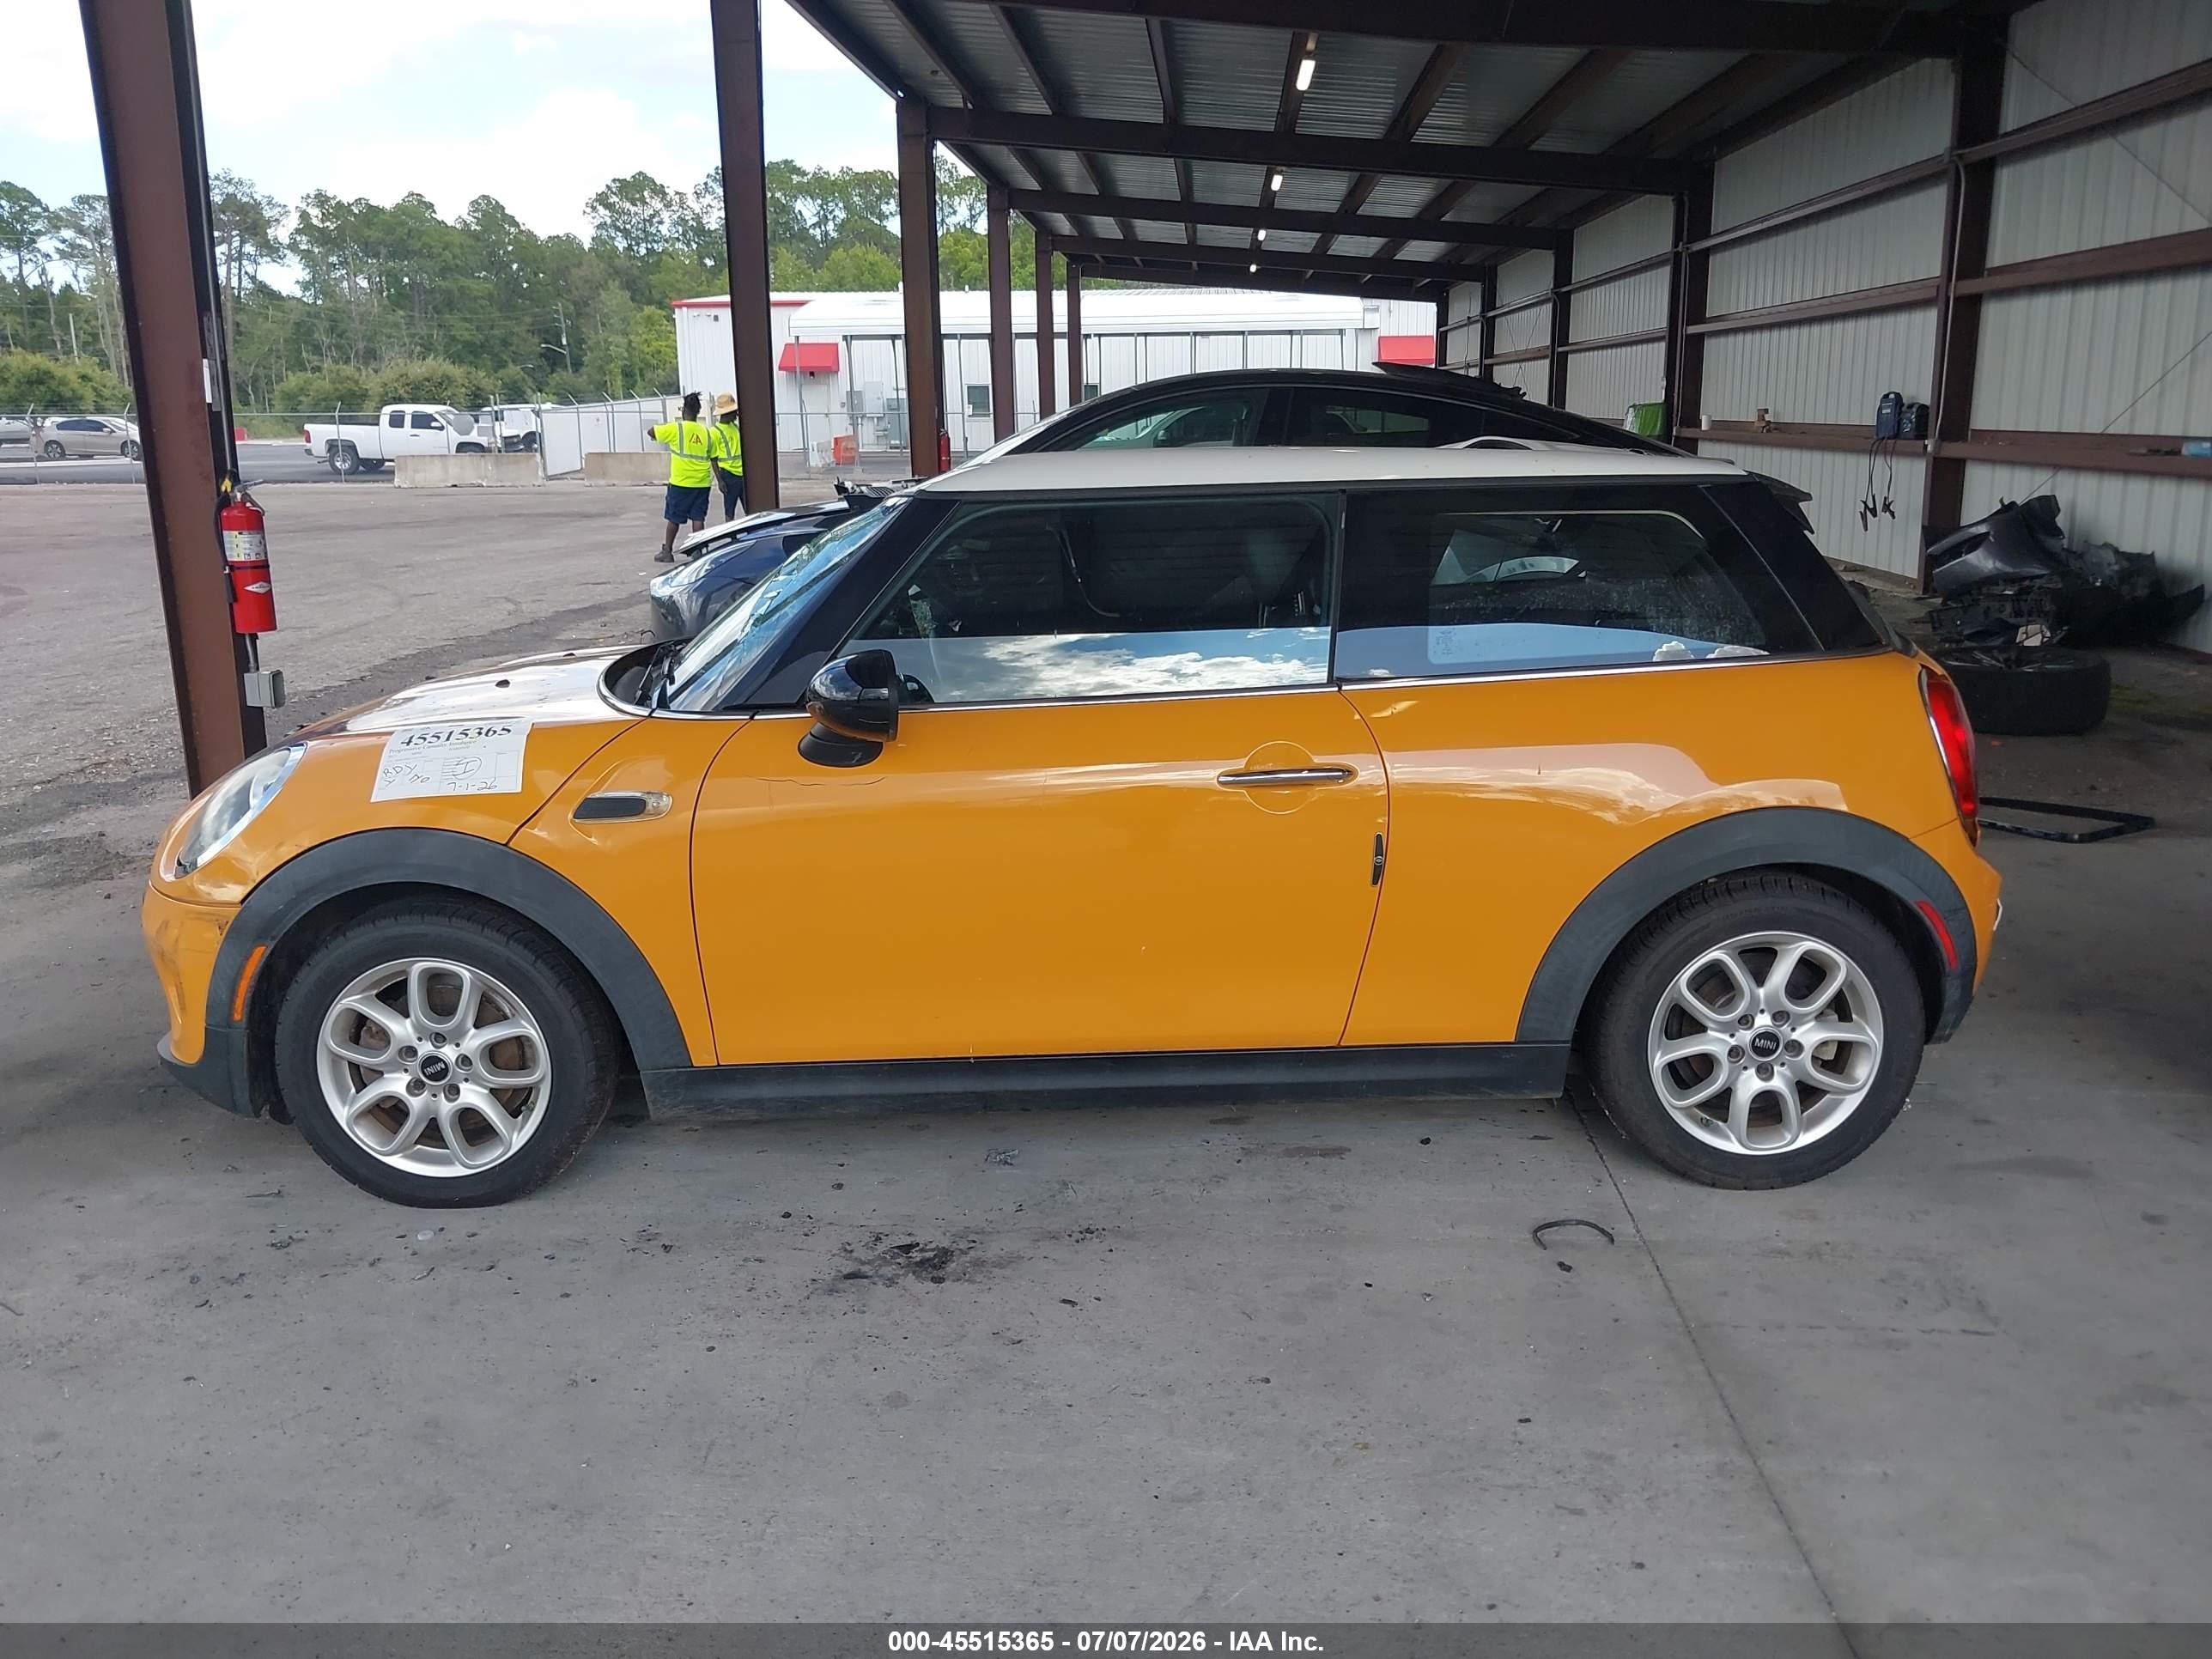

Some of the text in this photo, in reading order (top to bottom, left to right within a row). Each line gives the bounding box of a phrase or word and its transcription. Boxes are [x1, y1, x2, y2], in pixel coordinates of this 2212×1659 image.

[401, 725, 513, 746] 45515365
[1754, 1037, 1777, 1050] MINI
[423, 1060, 446, 1076] MINI
